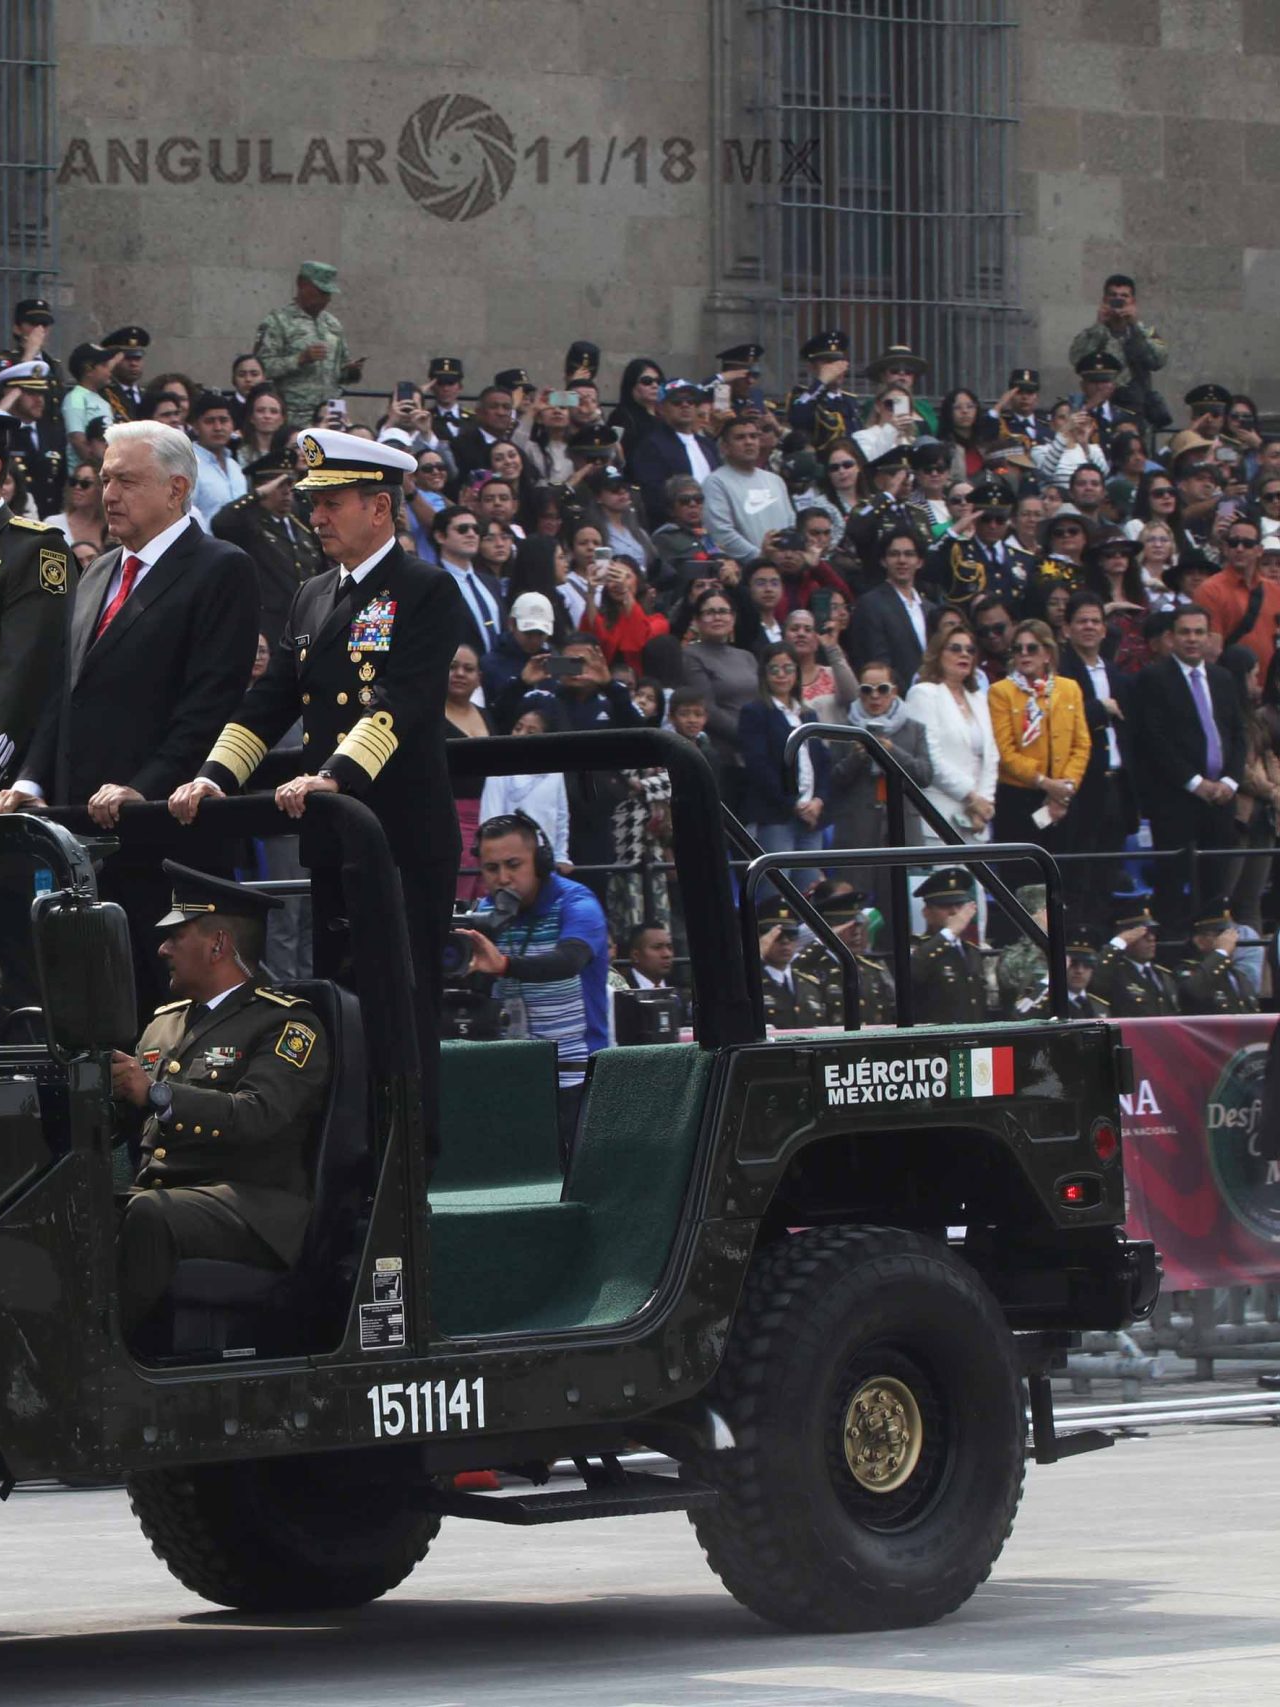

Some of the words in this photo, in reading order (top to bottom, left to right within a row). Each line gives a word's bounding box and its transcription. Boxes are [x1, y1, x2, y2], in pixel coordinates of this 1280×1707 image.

[824, 1056, 949, 1088] EJÉRCITO
[827, 1080, 947, 1106] MEXICANO
[366, 1376, 486, 1438] 1511141
